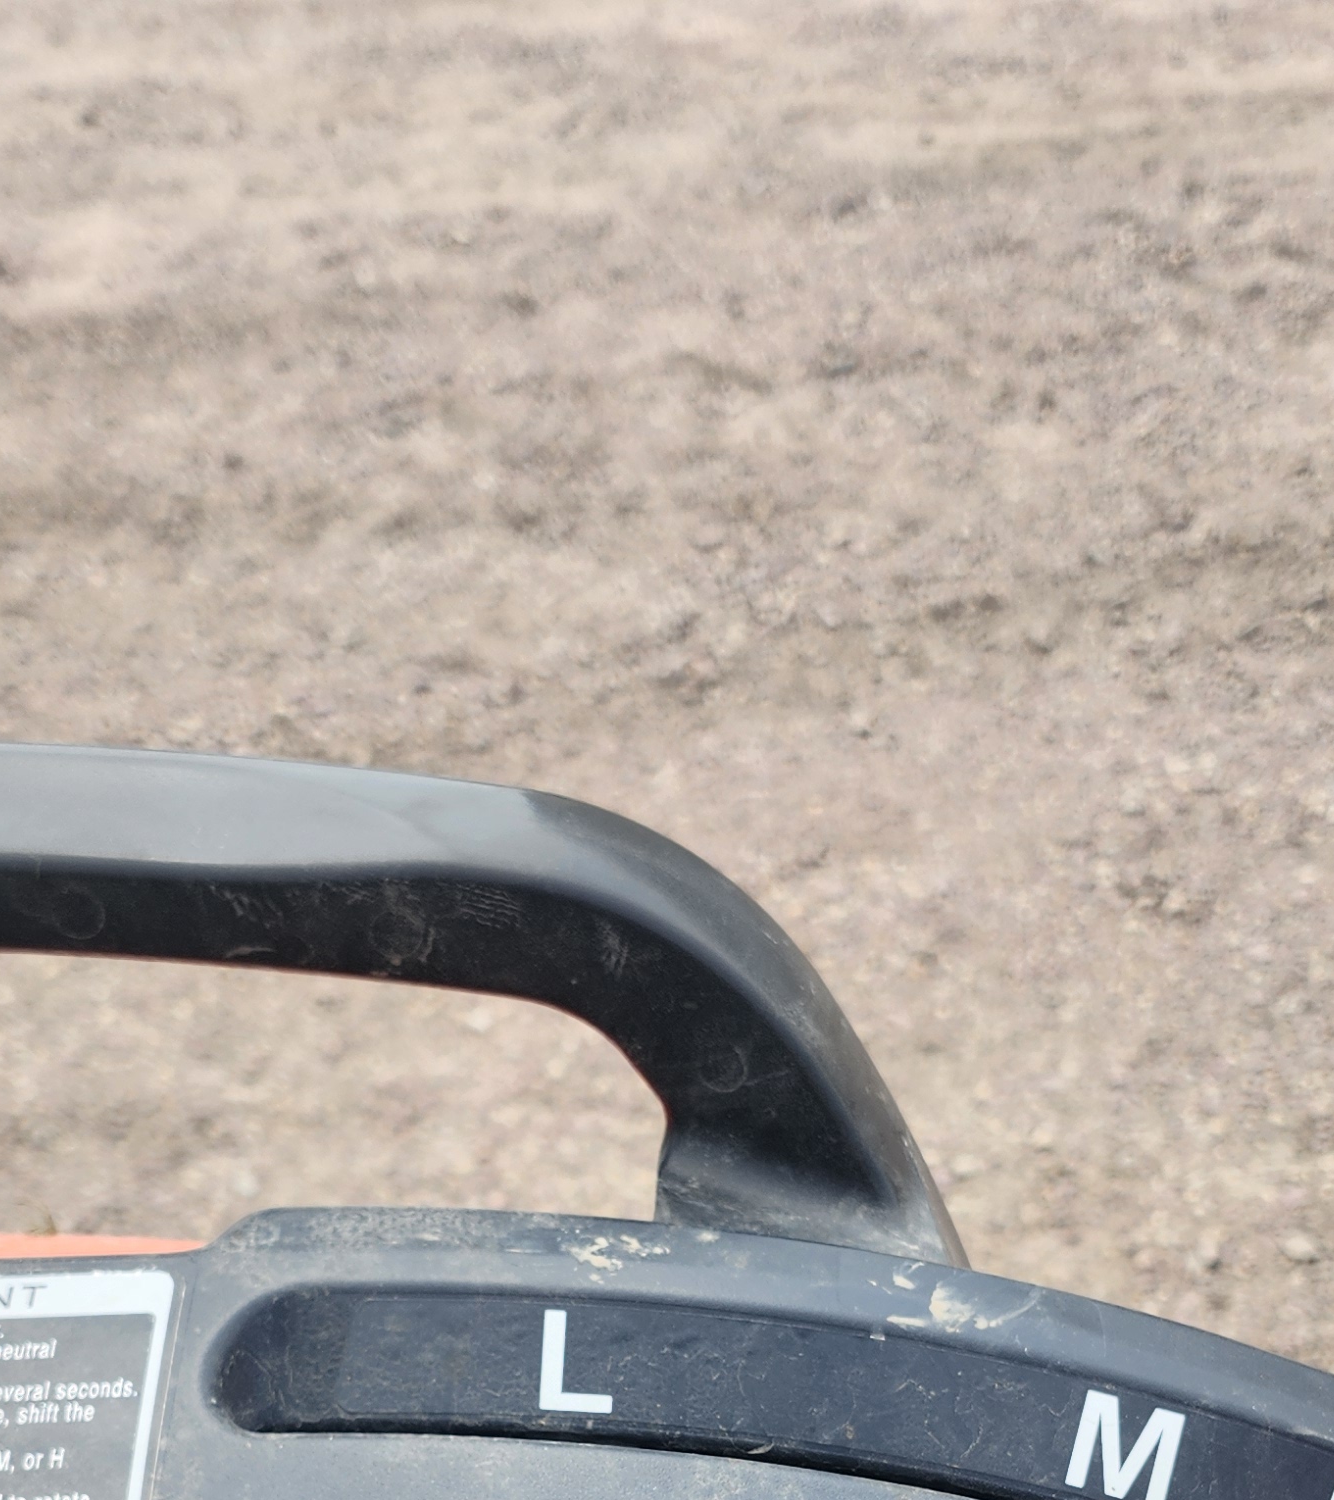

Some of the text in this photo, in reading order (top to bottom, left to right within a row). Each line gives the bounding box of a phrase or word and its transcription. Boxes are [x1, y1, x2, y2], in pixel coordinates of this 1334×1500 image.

[539, 1309, 613, 1414] L
[55, 1376, 139, 1400] seconds.
[16, 1402, 60, 1425] shift
[64, 1400, 96, 1422] the
[21, 1450, 45, 1471] or
[49, 1446, 66, 1470] H
